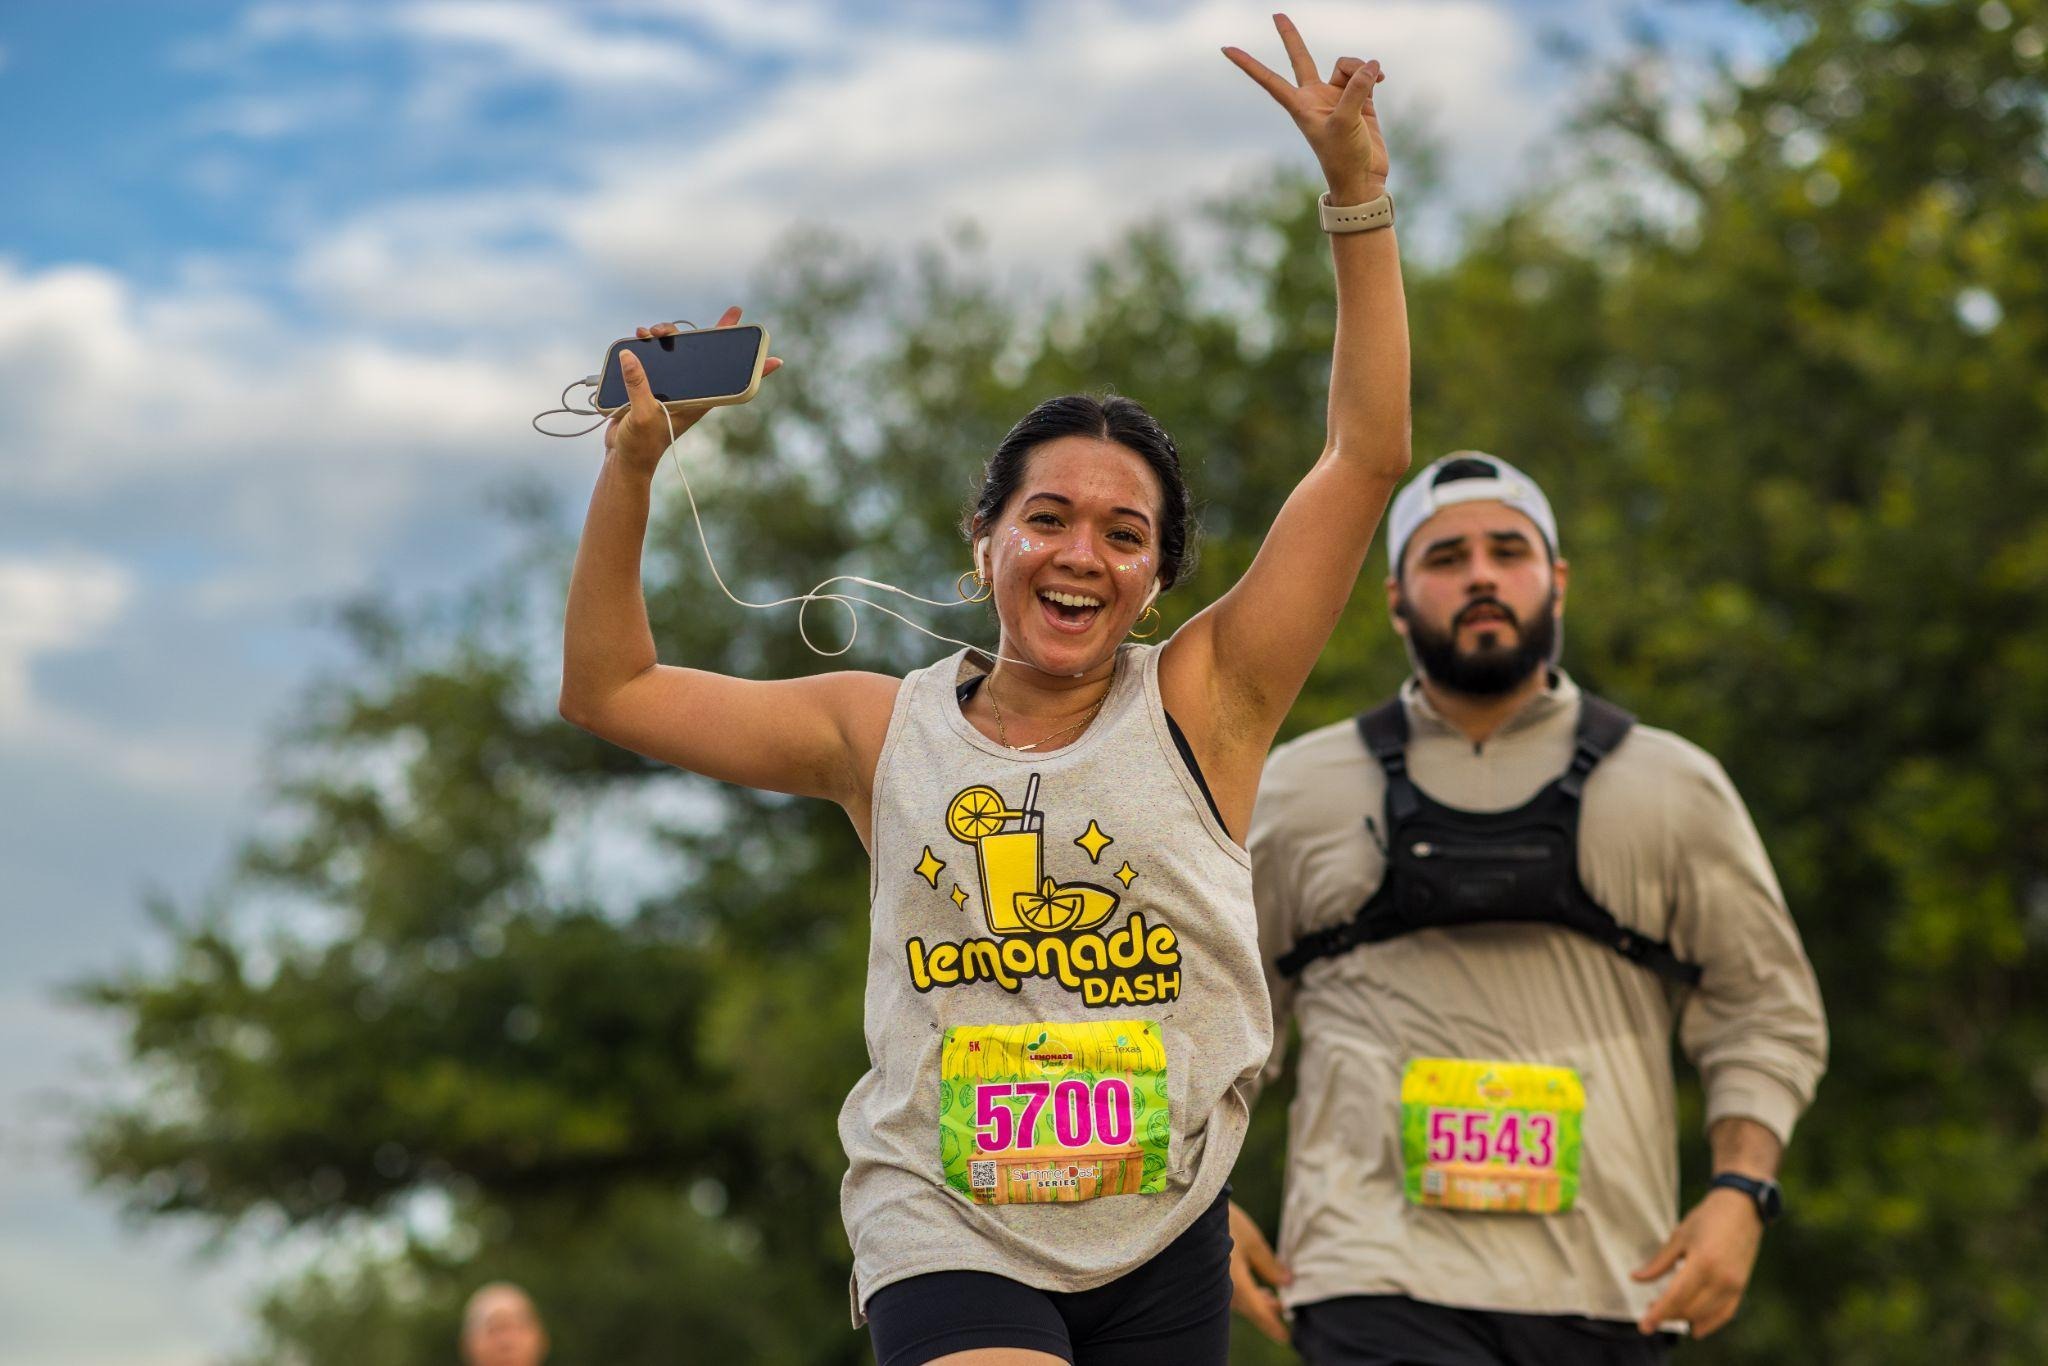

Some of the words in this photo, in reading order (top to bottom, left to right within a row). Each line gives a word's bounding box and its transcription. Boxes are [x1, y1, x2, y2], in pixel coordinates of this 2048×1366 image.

[907, 913, 1180, 990] lemonade
[1083, 971, 1180, 1005] DASH
[969, 1041, 980, 1052] 5K
[1030, 1053, 1073, 1061] LEMONADE
[1112, 1045, 1141, 1054] Texas
[976, 1078, 1133, 1153] 5700
[1429, 1112, 1554, 1169] 5543
[1038, 1179, 1076, 1188] SERIES
